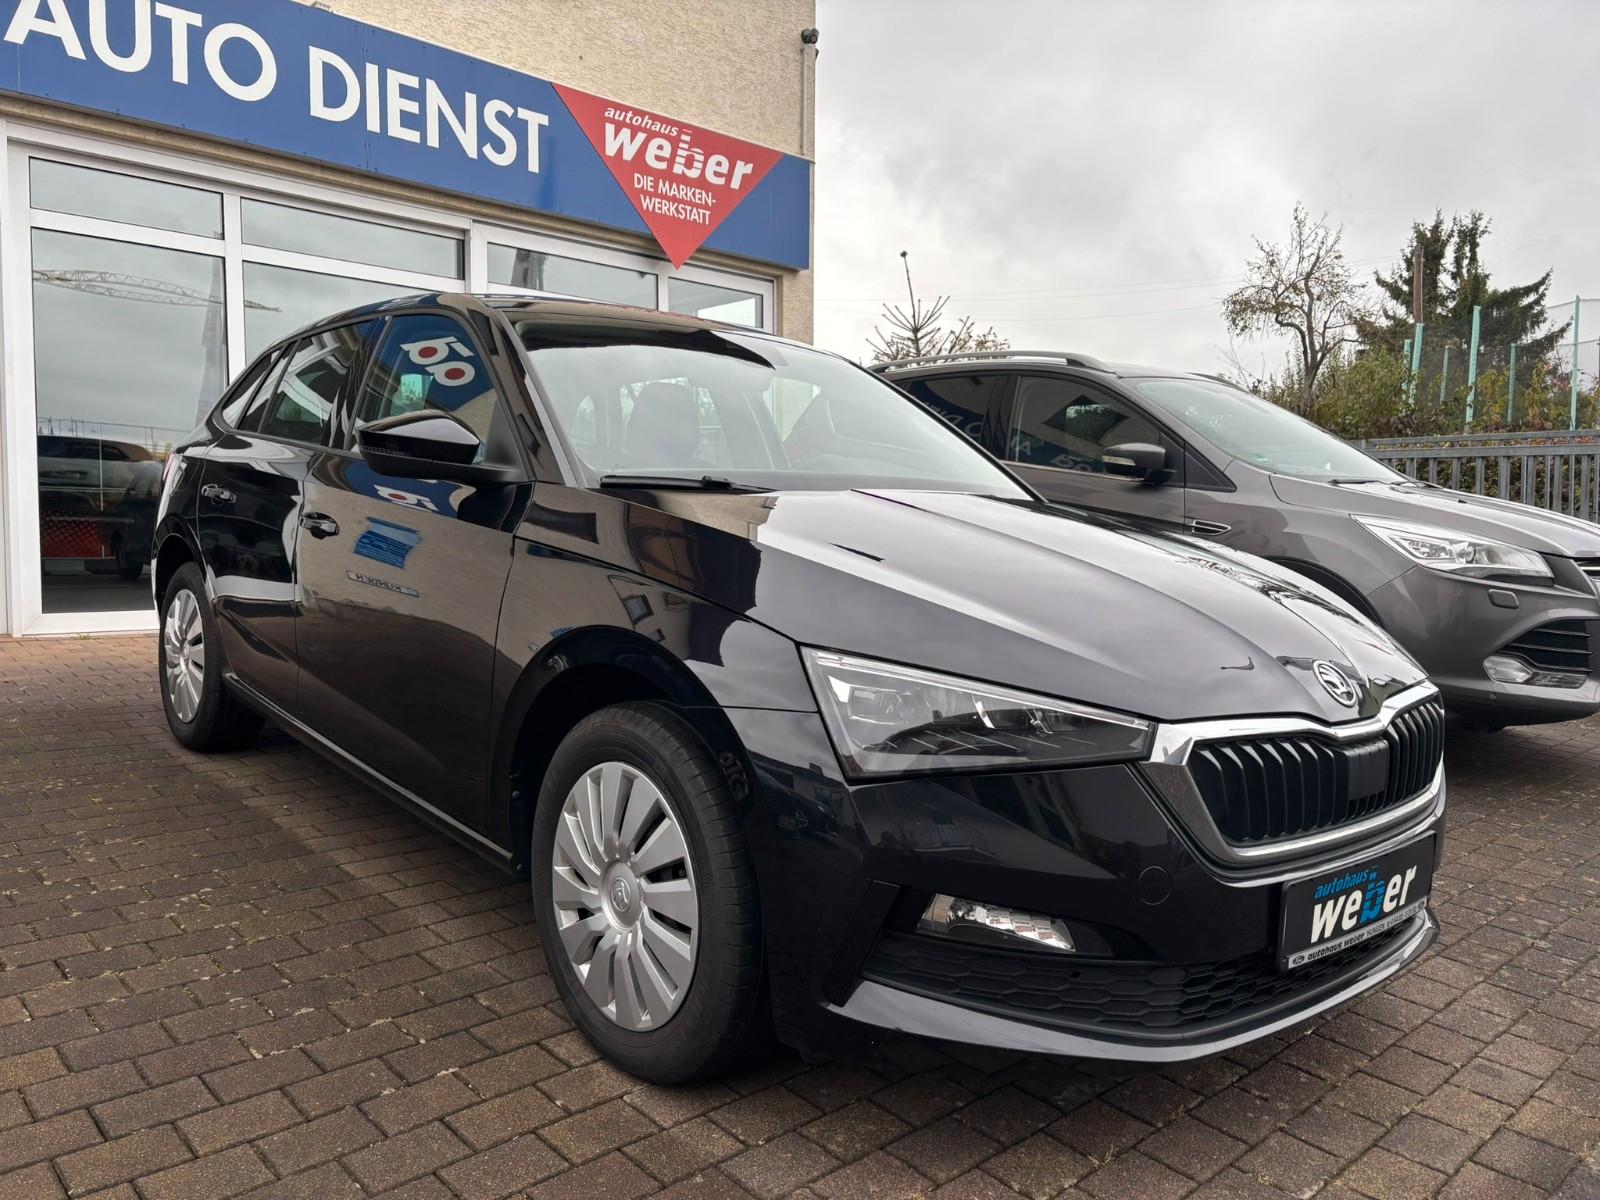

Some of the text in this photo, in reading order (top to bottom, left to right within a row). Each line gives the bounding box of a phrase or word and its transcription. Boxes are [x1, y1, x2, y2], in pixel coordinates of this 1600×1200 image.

[4, 0, 549, 174] AUTO DIENST
[604, 107, 679, 137] autohaus
[605, 123, 753, 190] weber
[633, 172, 717, 207] DIE MARKEN-
[640, 194, 711, 225] WERKSTATT
[1315, 870, 1369, 899] autohaus
[1311, 865, 1417, 943] weber
[1307, 942, 1342, 960] autohaus
[1344, 932, 1365, 948] weber
